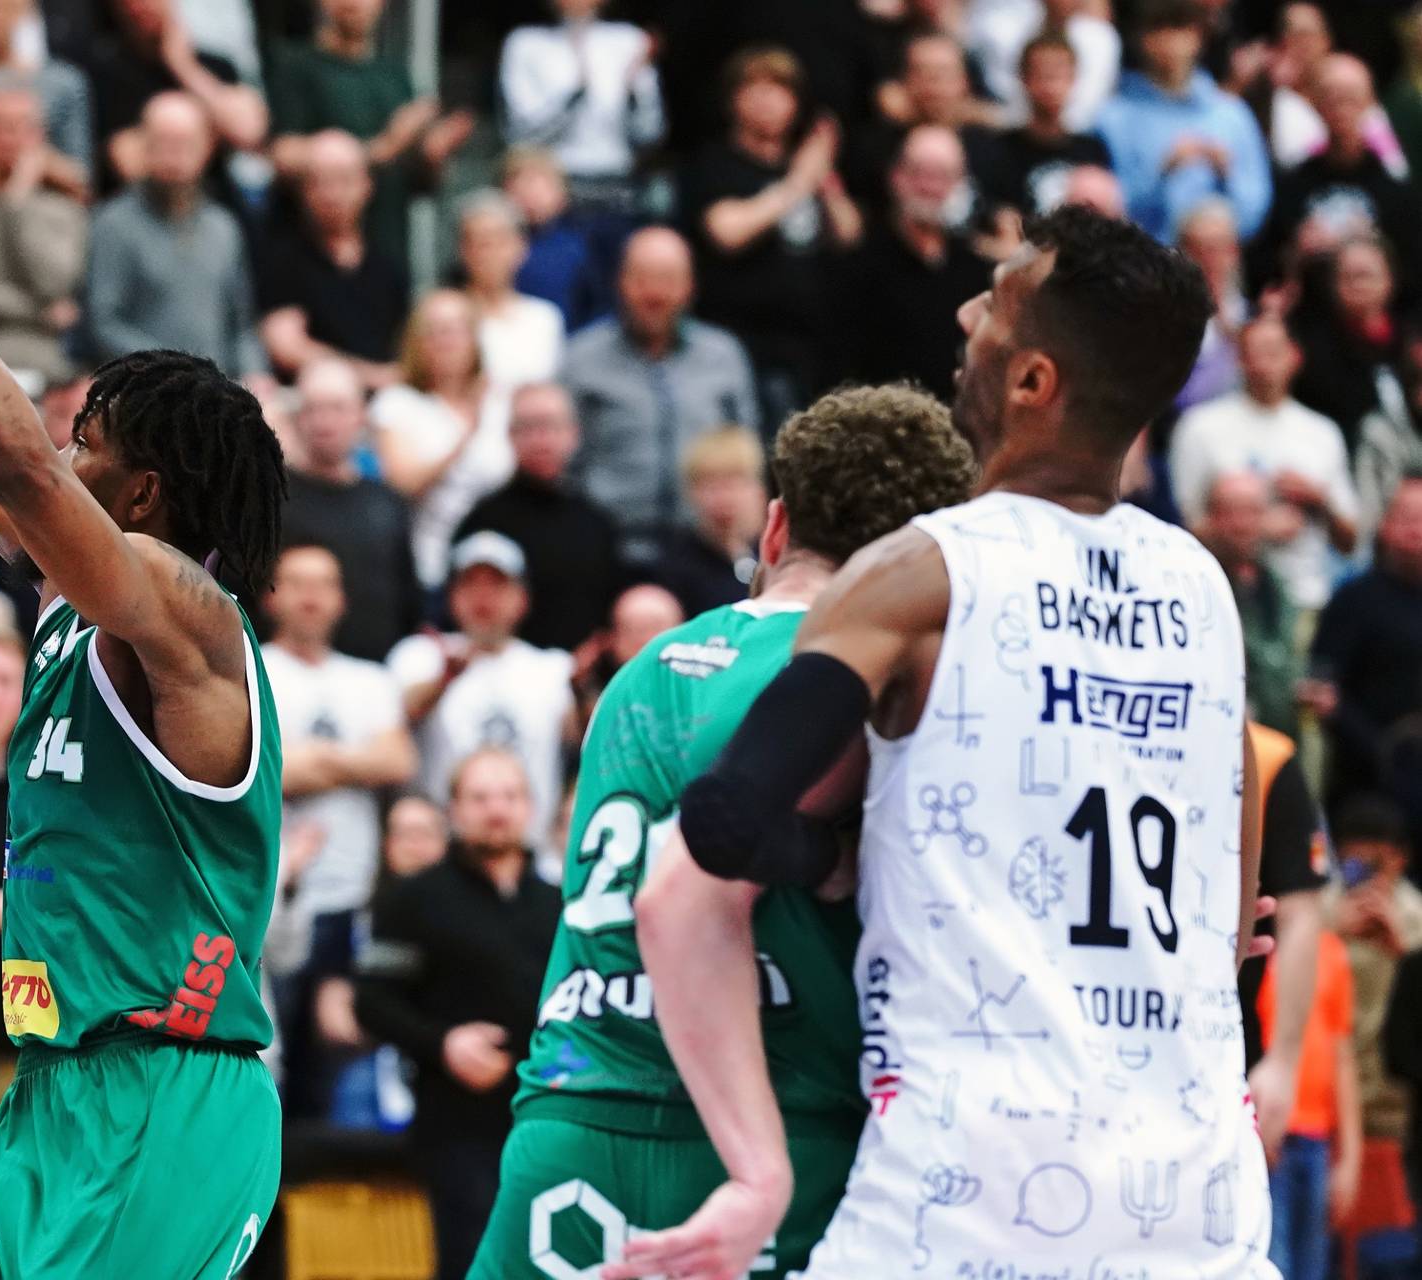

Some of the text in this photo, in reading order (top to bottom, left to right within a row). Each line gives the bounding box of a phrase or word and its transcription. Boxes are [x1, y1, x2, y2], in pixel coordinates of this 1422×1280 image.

[1037, 581, 1189, 649] BASKETS
[25, 716, 84, 785] 34
[566, 797, 678, 932] 2
[1064, 786, 1180, 955] 19
[2, 972, 52, 1010] TTO
